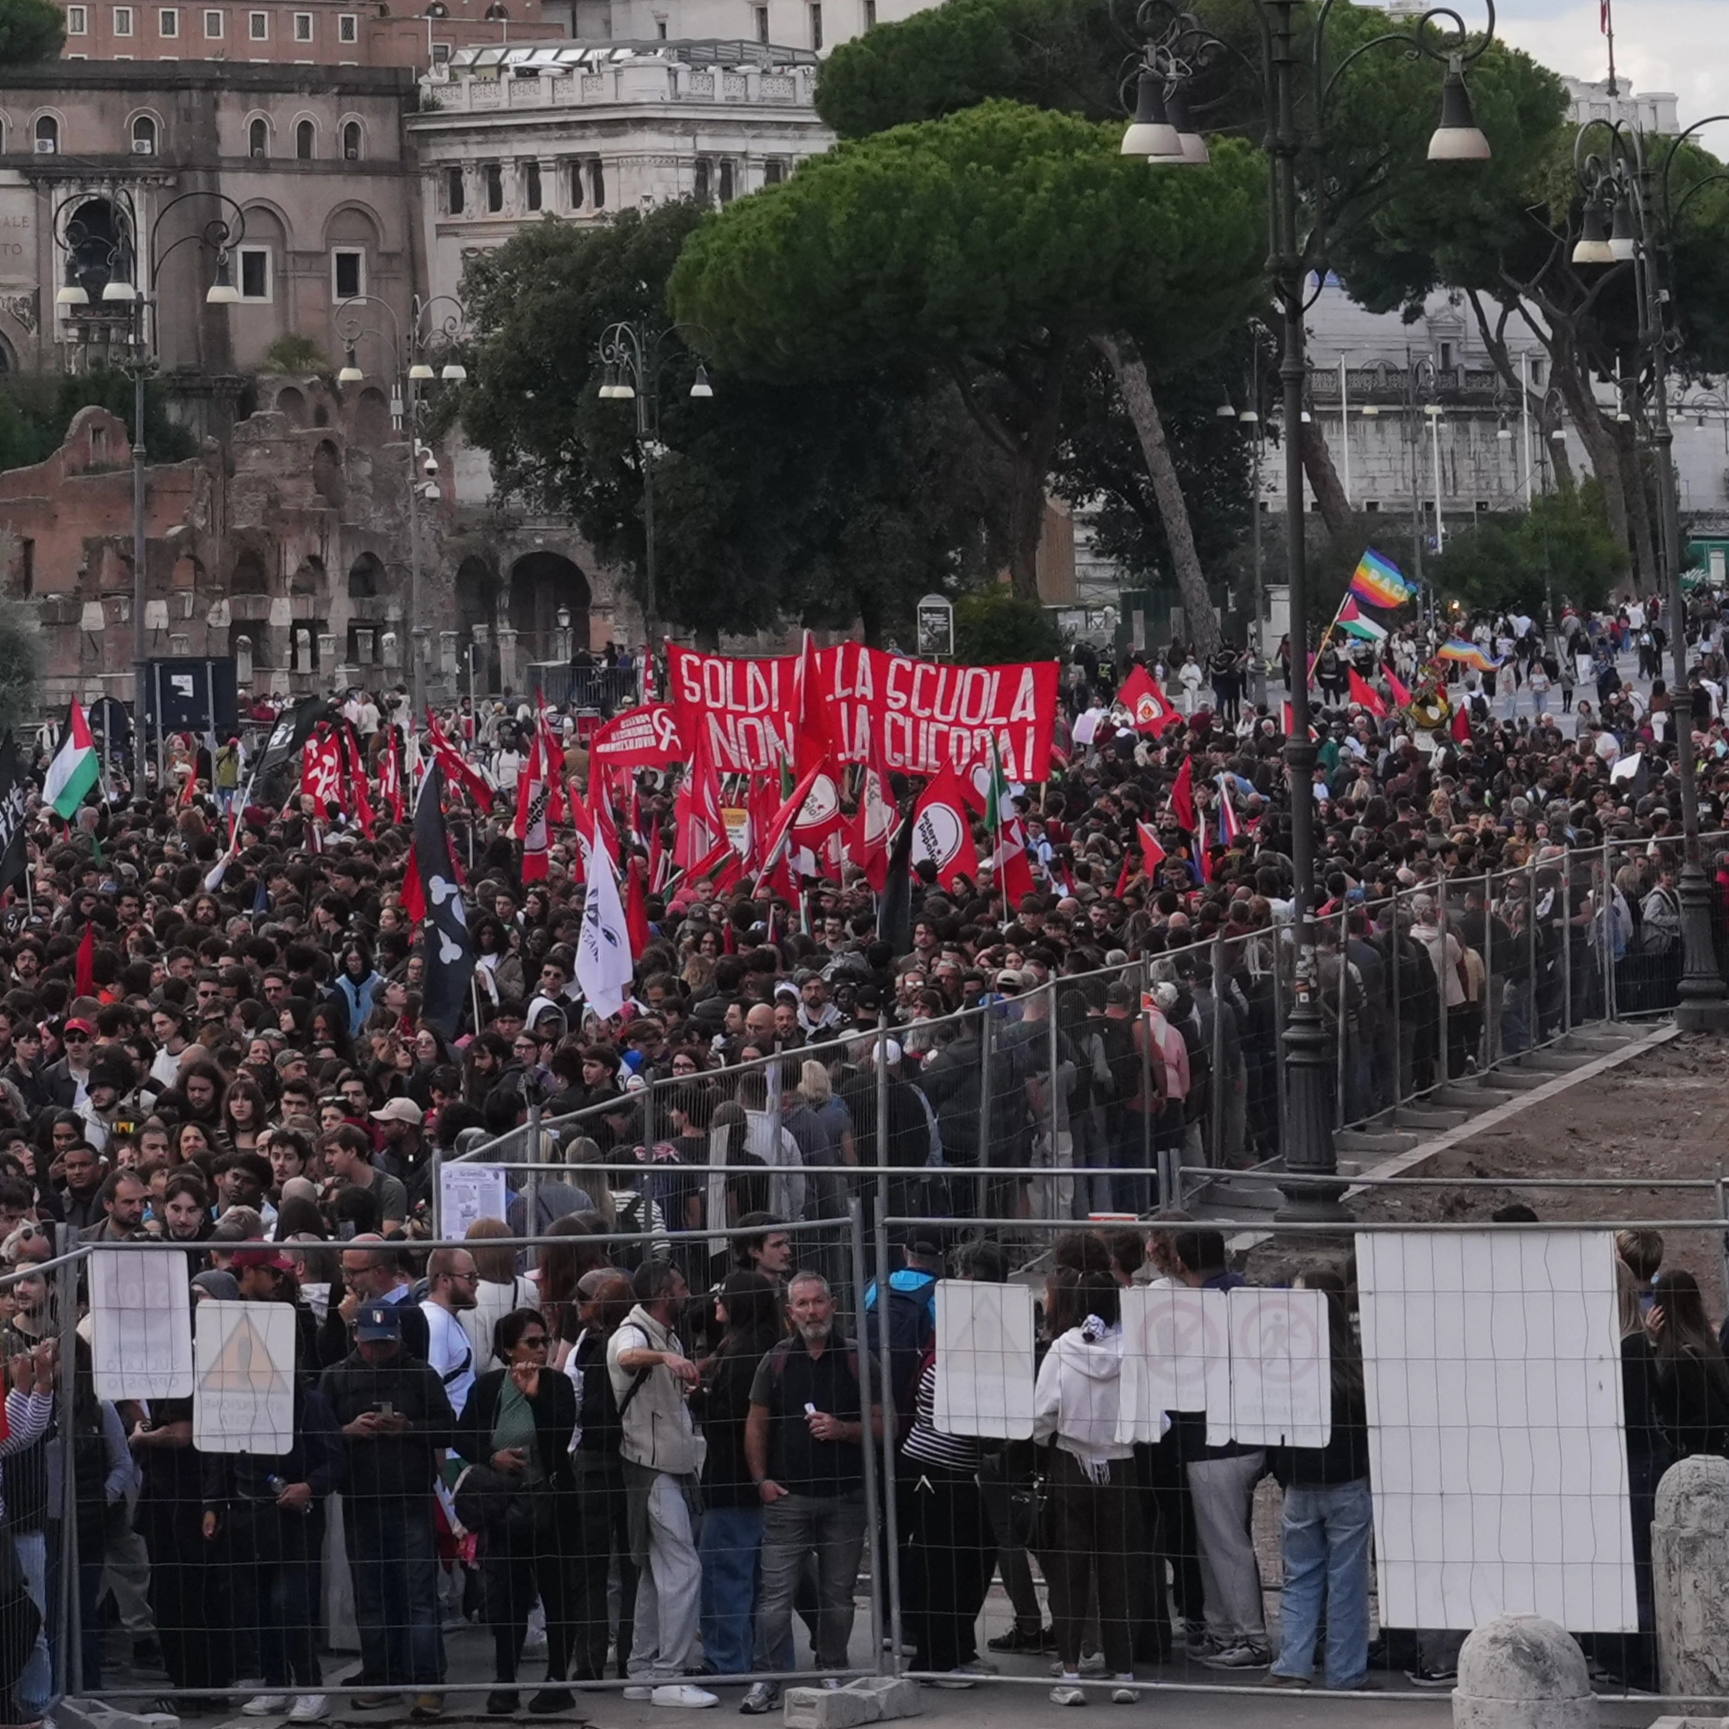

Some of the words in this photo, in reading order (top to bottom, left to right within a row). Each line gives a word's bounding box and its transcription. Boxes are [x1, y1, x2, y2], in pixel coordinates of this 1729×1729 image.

[680, 653, 779, 713] SOLDI
[886, 657, 1036, 725] SCUOLA
[706, 711, 794, 770] NON
